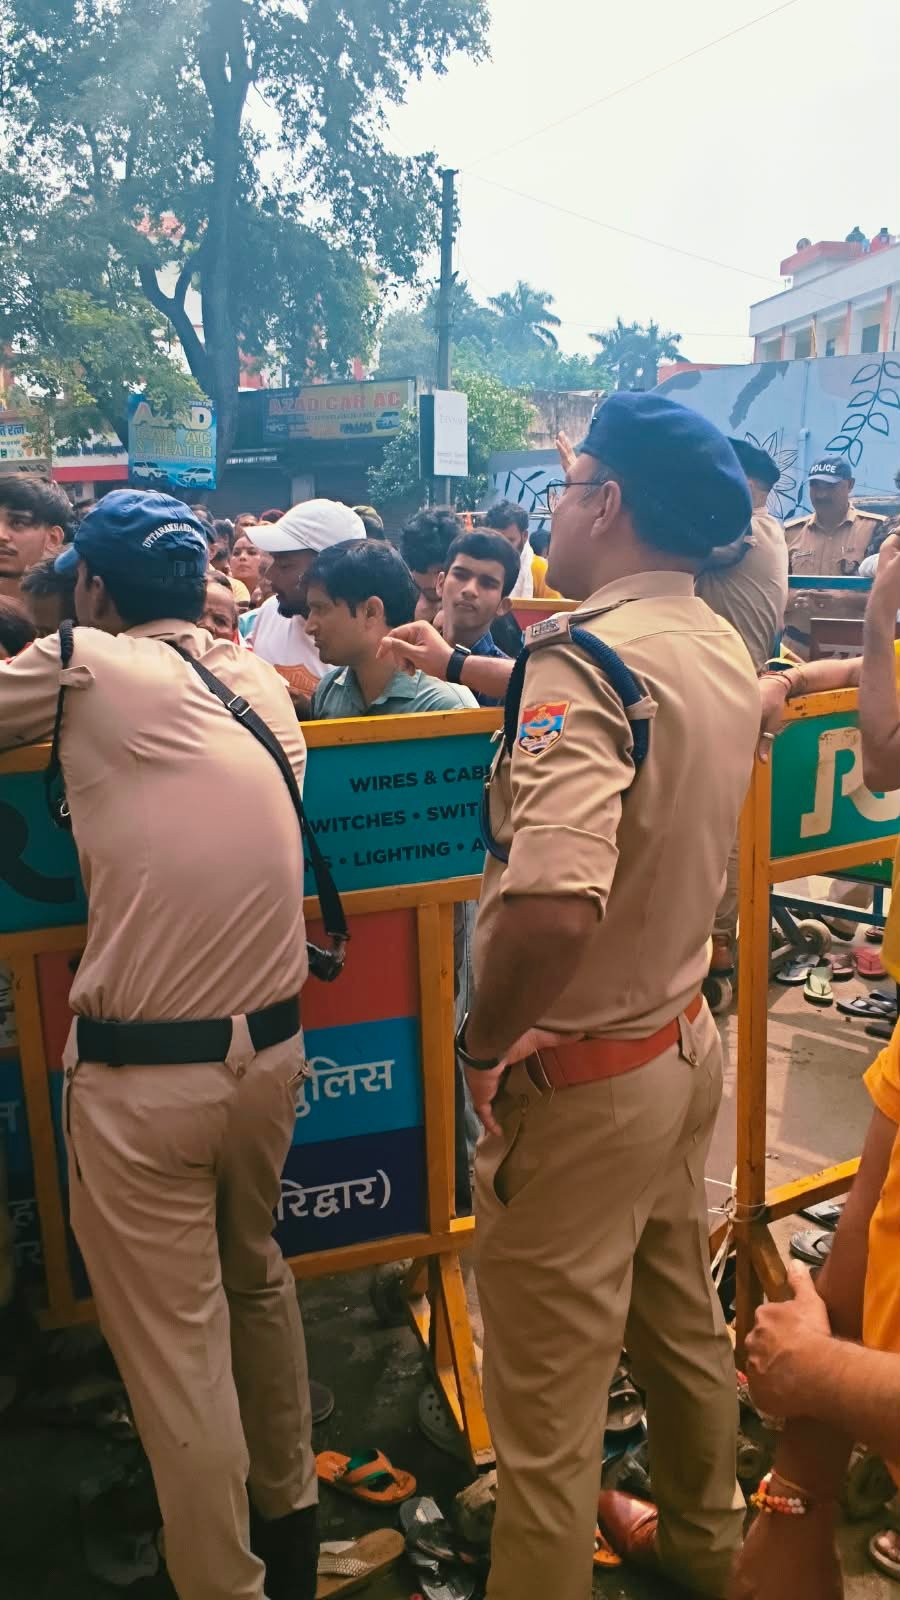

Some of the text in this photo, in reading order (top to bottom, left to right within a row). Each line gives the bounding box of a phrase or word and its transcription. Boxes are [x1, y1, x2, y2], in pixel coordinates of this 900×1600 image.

[269, 391, 401, 416] AZAD CAR AC
[185, 431, 211, 446] AC
[154, 445, 212, 459] HEATER
[810, 464, 837, 474] POLICE
[350, 771, 418, 793] WIRES
[424, 770, 437, 785] &
[310, 802, 479, 835] WITCHES SWIT
[354, 841, 450, 867] LIGHTING
[472, 838, 488, 853] A
[278, 1169, 391, 1221] रिद्वार)
